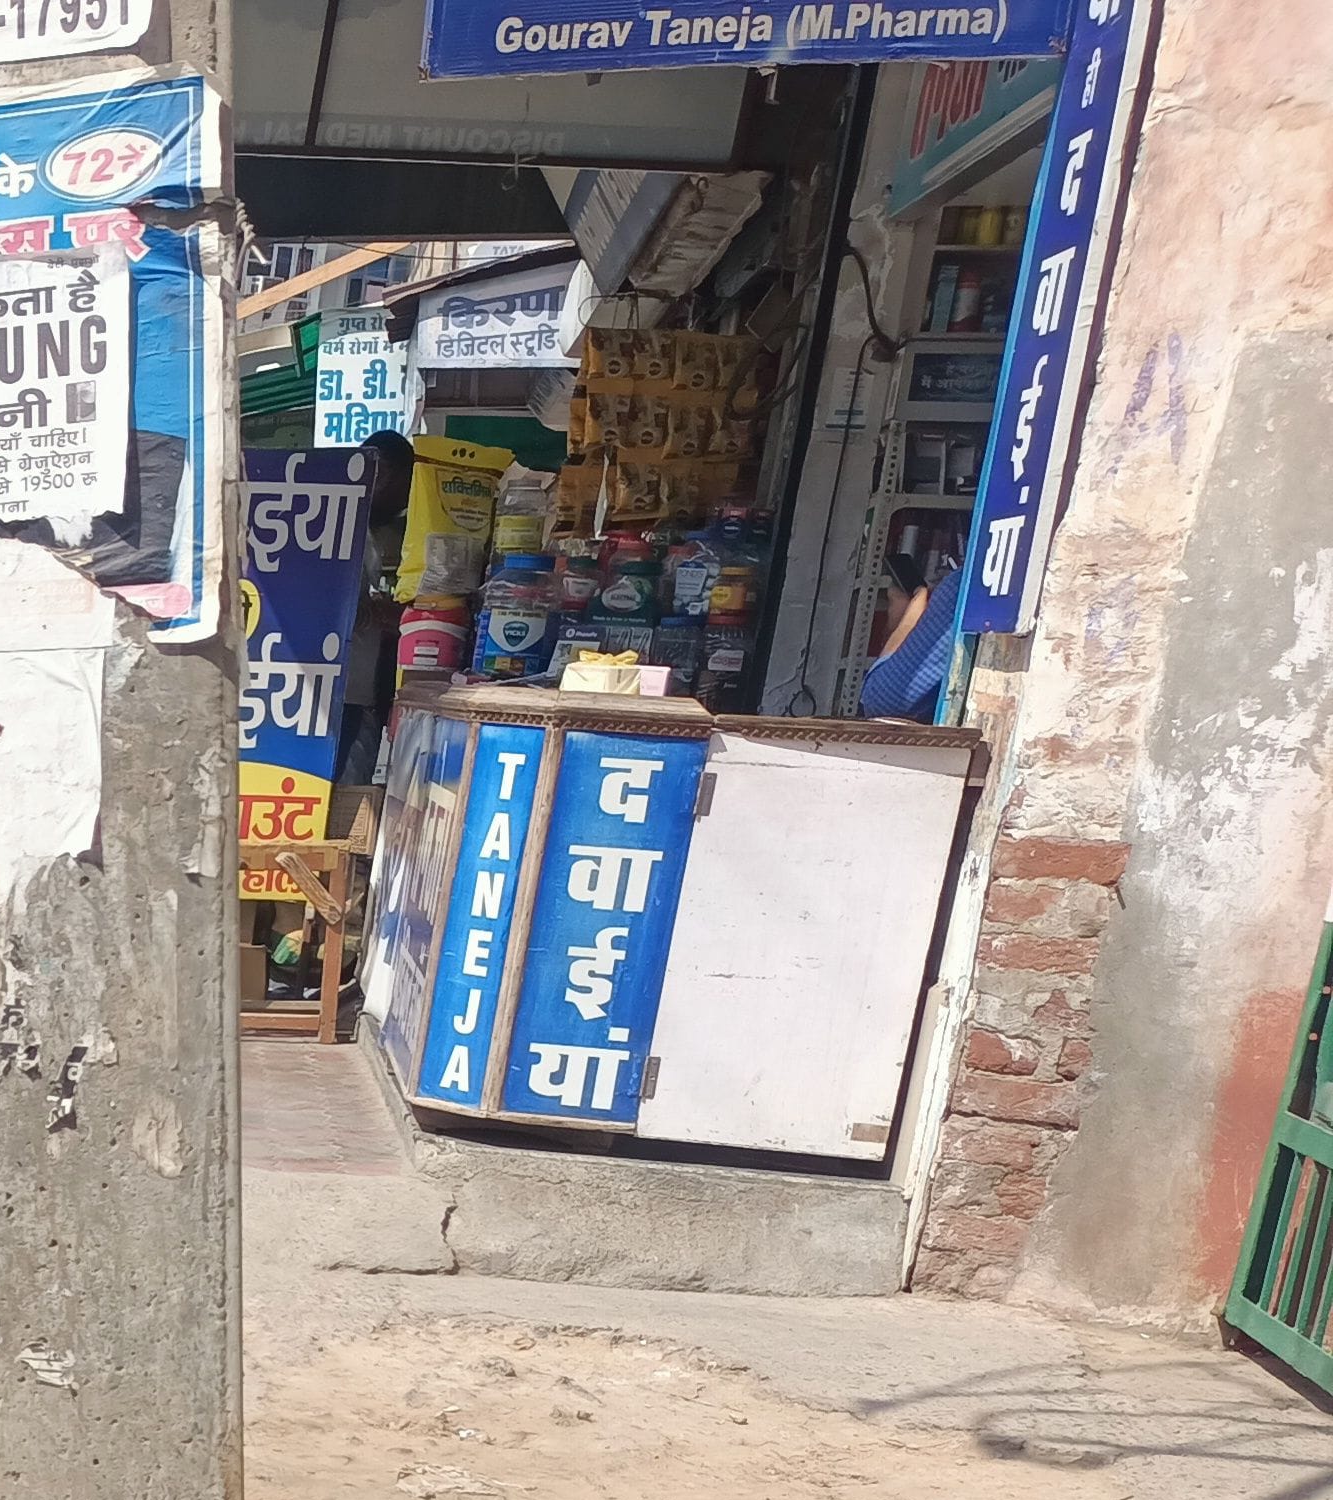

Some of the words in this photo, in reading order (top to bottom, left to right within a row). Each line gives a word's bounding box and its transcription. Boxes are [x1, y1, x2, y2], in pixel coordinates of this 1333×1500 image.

[494, 16, 633, 55] Gourav
[645, 9, 773, 51] Taneja
[785, 0, 1008, 50] (M.Pharma)
[66, 269, 101, 314] है
[437, 285, 567, 332] किरण
[434, 330, 506, 359] डिजिटल
[318, 368, 353, 401] डा.
[363, 359, 397, 400] डी.
[20, 471, 76, 494] 19500
[438, 752, 527, 1092] TANEJA
[527, 755, 664, 1112] दवाईयां
